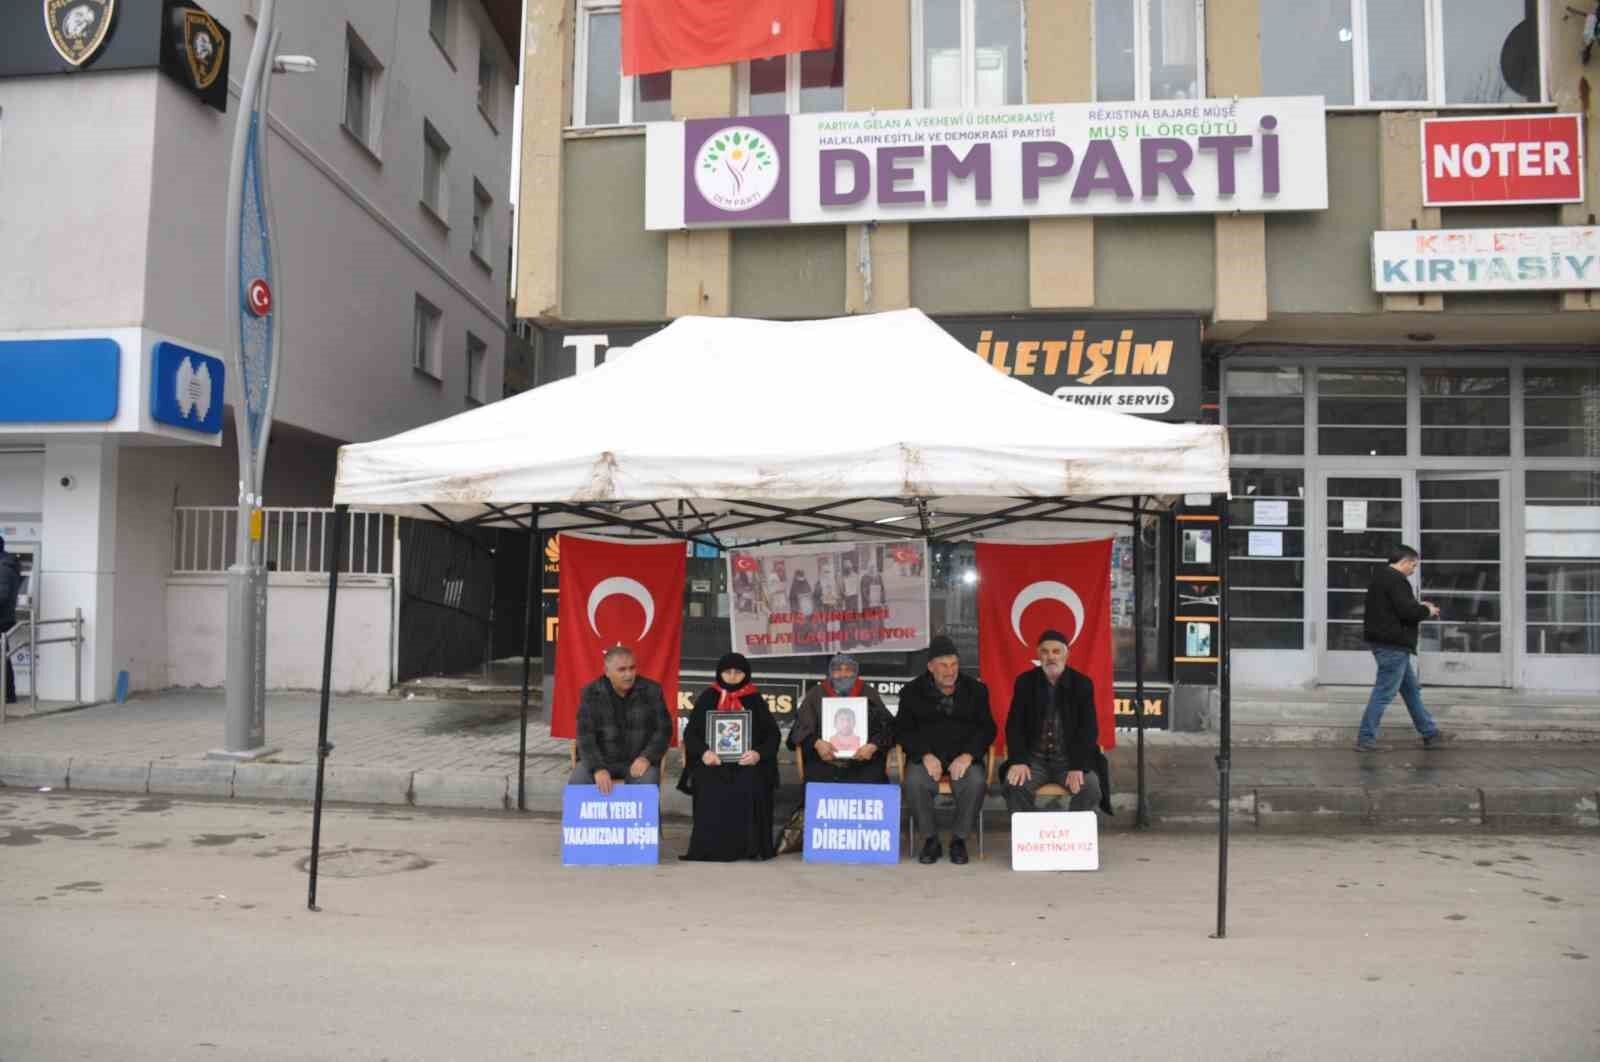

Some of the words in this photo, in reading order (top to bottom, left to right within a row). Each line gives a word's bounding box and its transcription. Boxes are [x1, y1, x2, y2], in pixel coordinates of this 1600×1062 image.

[864, 118, 901, 130] GELAN
[904, 118, 912, 128] A
[1088, 127, 1129, 141] MUŞ
[1135, 124, 1150, 137] İL
[1158, 121, 1238, 136] ÖRGÜTÜ
[819, 134, 882, 146] HALKLARIN
[884, 131, 925, 144] EŞİTLİK
[928, 131, 942, 142] VE
[945, 129, 1008, 141] DEMOKRASİ
[1012, 127, 1056, 138] PARTİSİ
[819, 143, 993, 207] DEM
[1021, 114, 1281, 202] PARTİ
[1433, 141, 1572, 178] NOTER
[1382, 252, 1600, 282] KIRTASİY
[976, 329, 1174, 385] İLETİŞİM
[1117, 392, 1170, 406] SERVİS
[580, 801, 609, 819] ARTIK
[816, 799, 884, 820] ANNELER
[812, 823, 891, 851] DİRENİYOR
